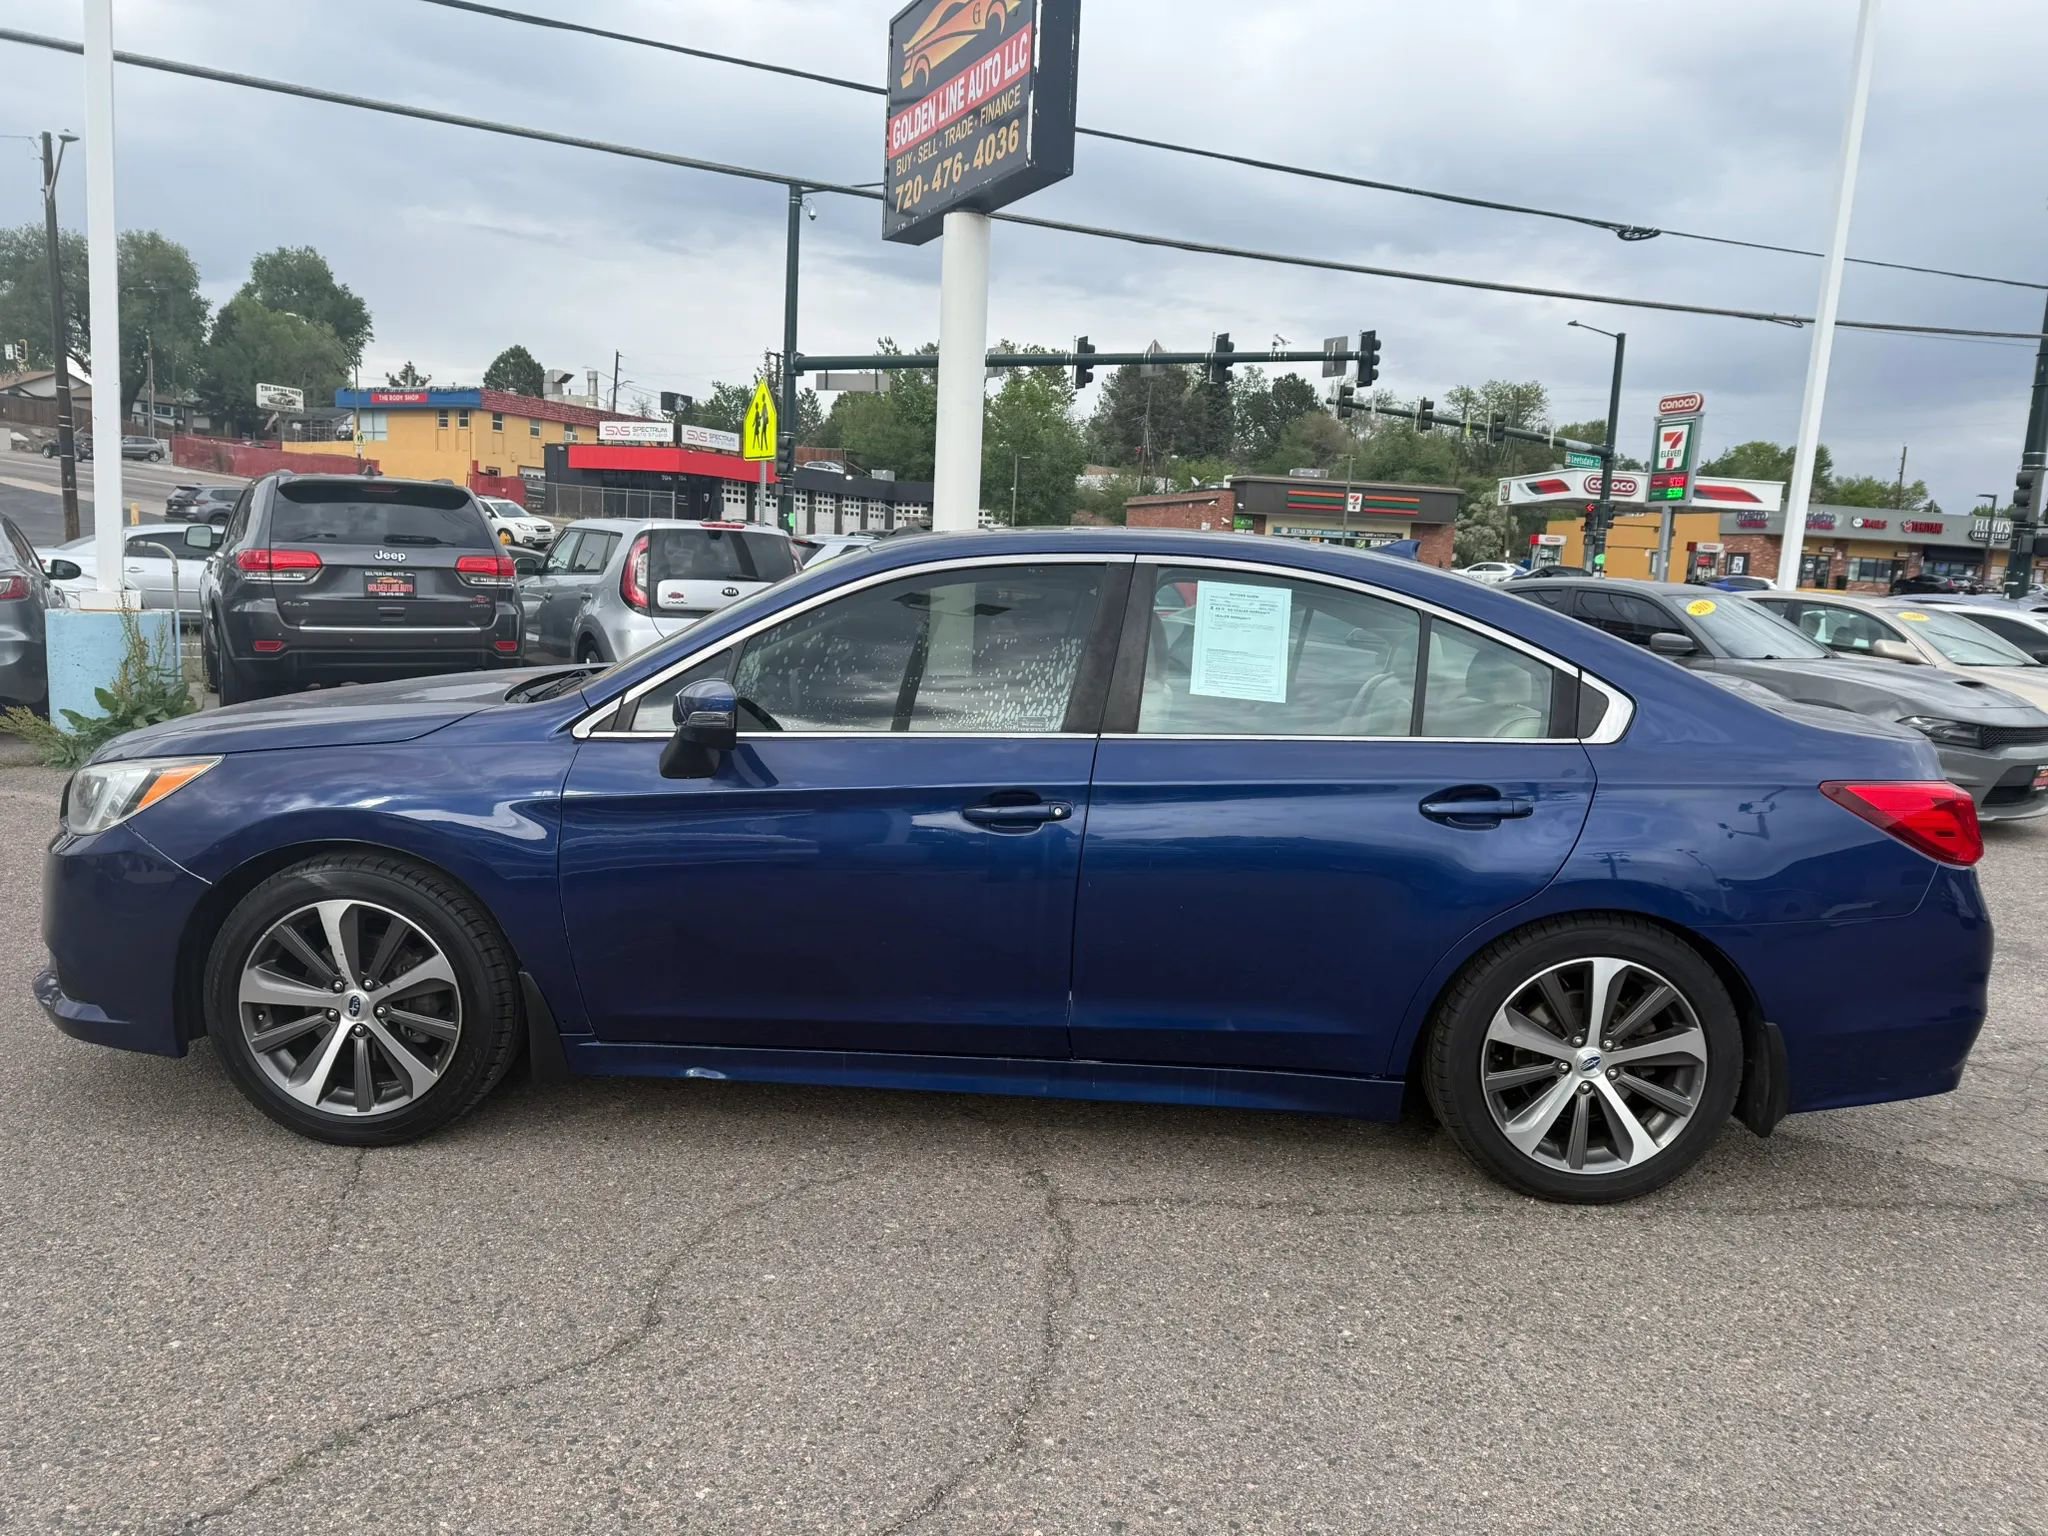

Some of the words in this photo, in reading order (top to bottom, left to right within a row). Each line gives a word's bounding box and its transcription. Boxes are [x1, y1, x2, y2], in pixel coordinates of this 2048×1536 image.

[892, 94, 936, 150] GOLDEN
[939, 75, 965, 122] LINE
[967, 52, 1000, 105] AUTO
[1004, 31, 1028, 81] LLC
[896, 152, 913, 177] BUY
[917, 140, 938, 164] SELL
[944, 115, 974, 149] TRADE
[980, 84, 1021, 127] FINANCE
[709, 433, 736, 442] SPECTRUM
[374, 550, 406, 562] Jeep
